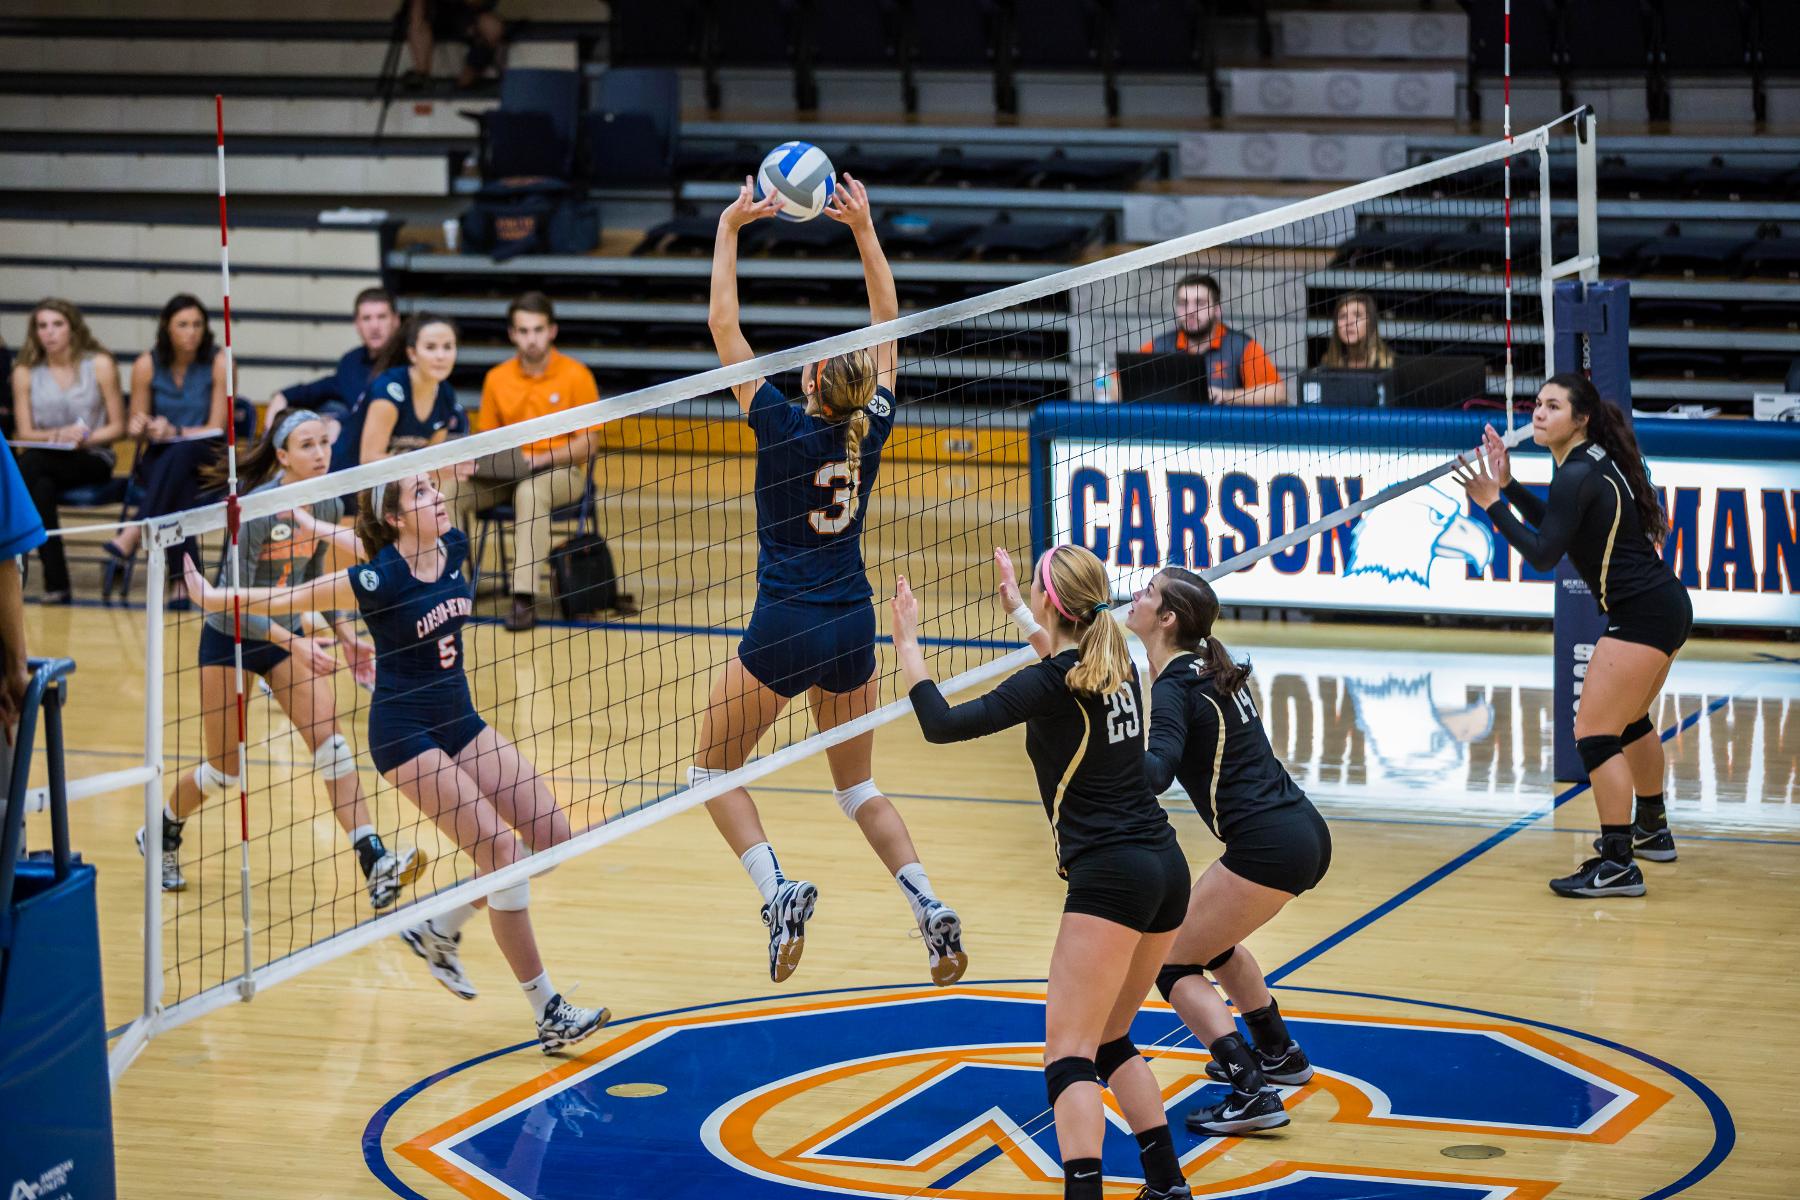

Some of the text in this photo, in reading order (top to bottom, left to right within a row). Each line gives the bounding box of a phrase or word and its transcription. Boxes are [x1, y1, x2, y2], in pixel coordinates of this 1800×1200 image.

[808, 461, 861, 535] 3
[1069, 466, 1363, 575] CARSON
[438, 634, 458, 670] 5
[1103, 681, 1140, 745] 29
